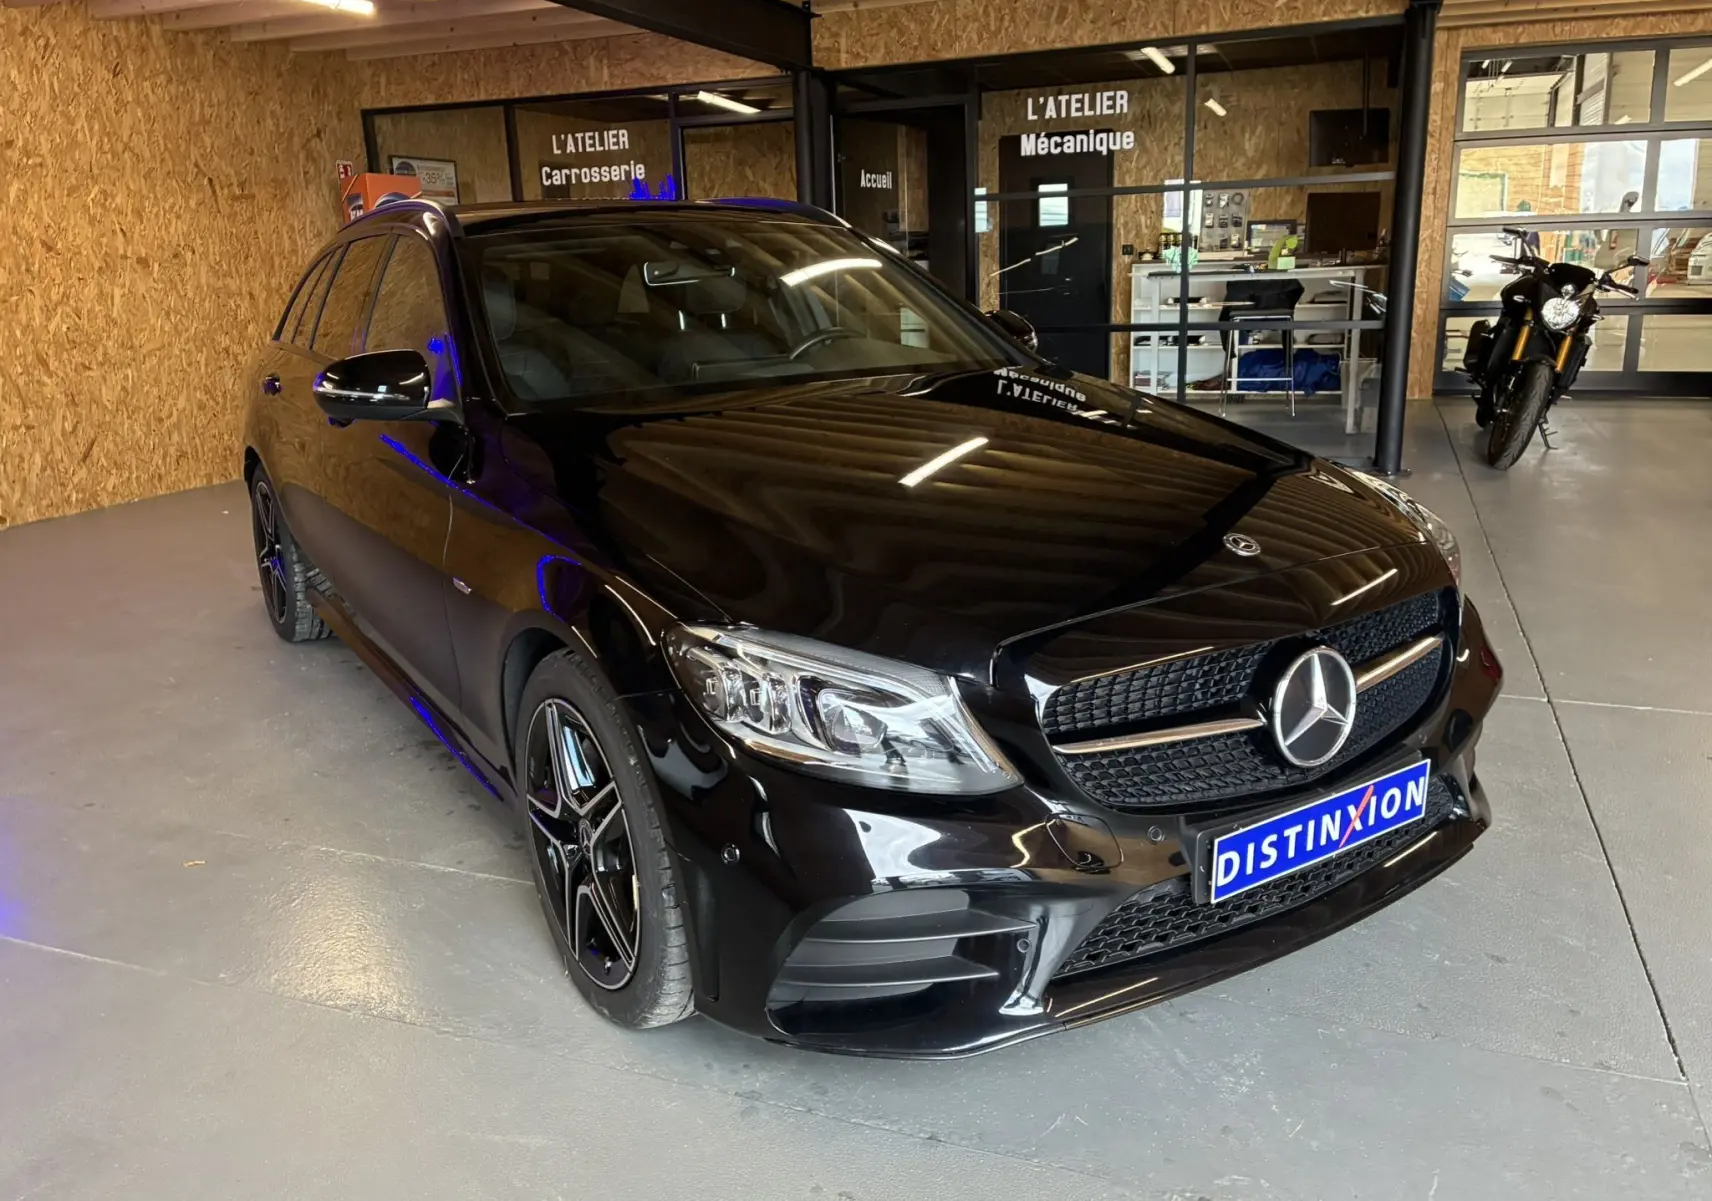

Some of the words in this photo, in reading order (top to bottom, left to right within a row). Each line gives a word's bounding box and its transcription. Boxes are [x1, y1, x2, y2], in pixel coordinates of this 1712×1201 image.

[1027, 90, 1128, 121] L'ATELIER
[552, 129, 629, 154] L'ATELIER
[1020, 129, 1135, 156] Mécanique
[541, 160, 646, 186] Carrosserie
[860, 169, 893, 189] Accueil
[1216, 776, 1425, 887] DISTINXION
